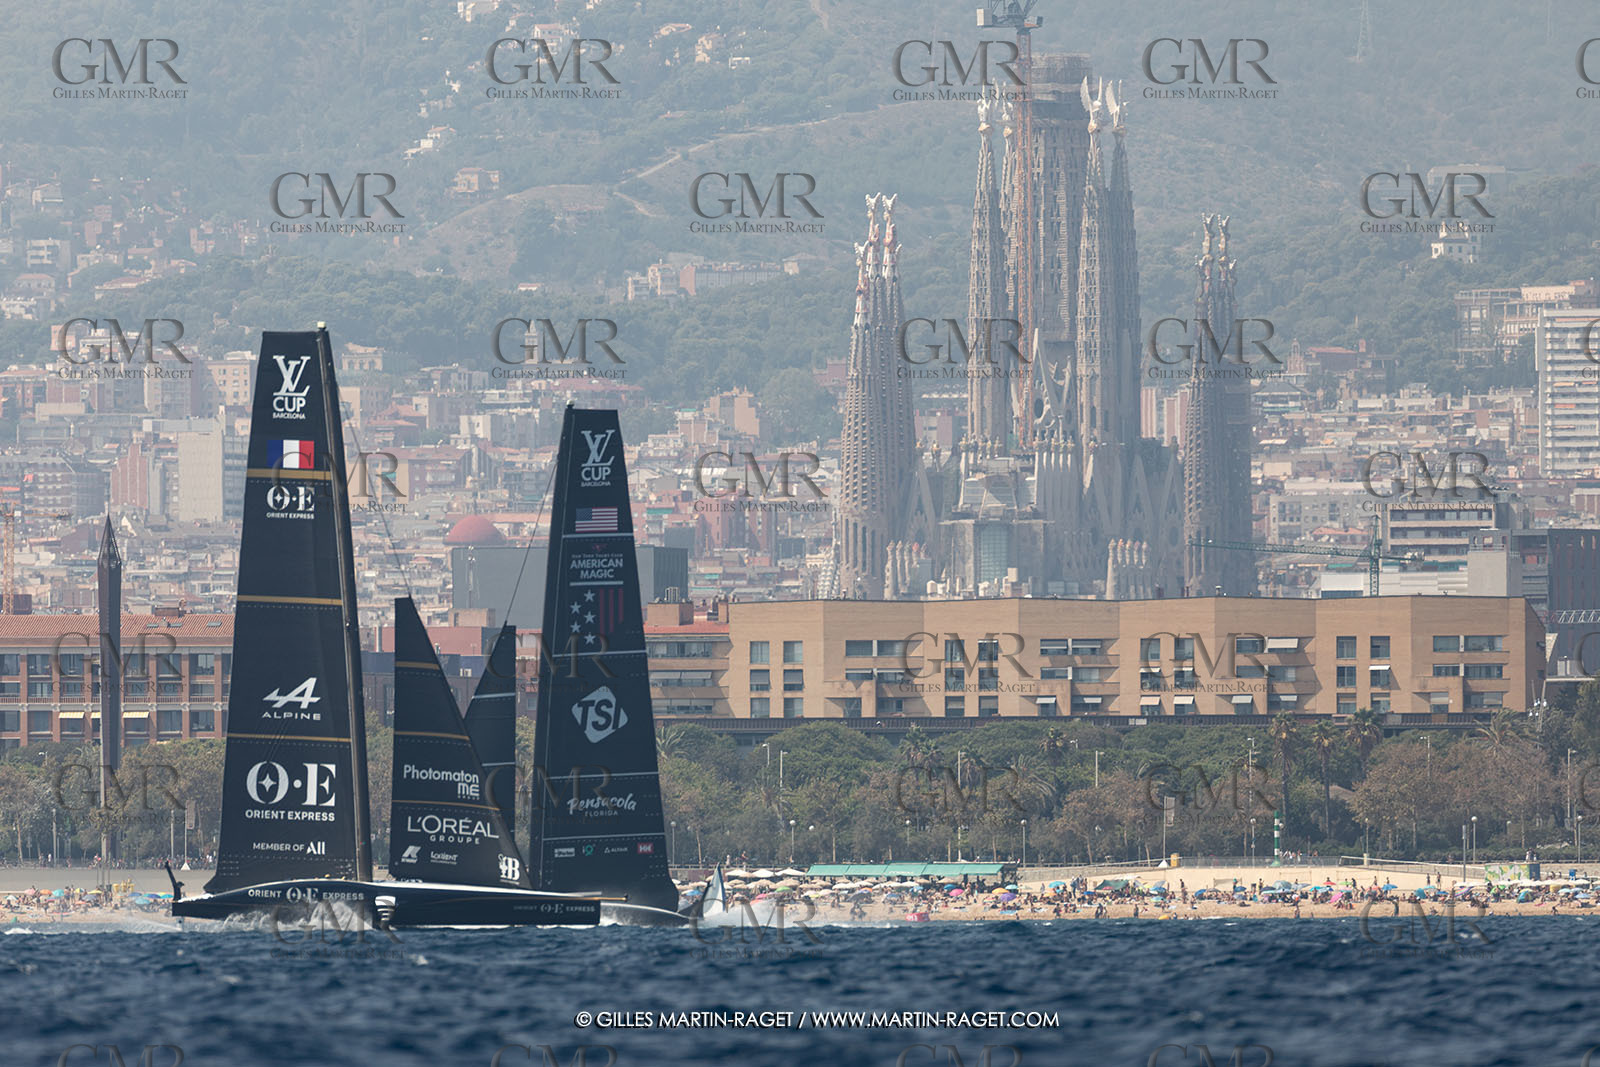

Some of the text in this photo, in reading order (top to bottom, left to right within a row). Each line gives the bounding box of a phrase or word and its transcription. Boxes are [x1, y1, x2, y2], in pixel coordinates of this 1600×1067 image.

[273, 396, 306, 412] CUP
[581, 466, 611, 481] CUP
[569, 558, 624, 569] AMERICAN
[580, 569, 615, 579] MAGIC
[262, 712, 321, 720] ALPINE
[404, 764, 479, 783] Photomaton
[567, 793, 637, 815] Pensacola
[245, 809, 335, 821] ORIENT EXPRESS
[430, 835, 480, 844] GROUPE
[253, 842, 291, 851] MEMBER
[292, 844, 305, 852] OF
[248, 889, 282, 898] ORIENT
[322, 892, 365, 901] EXPRESS
